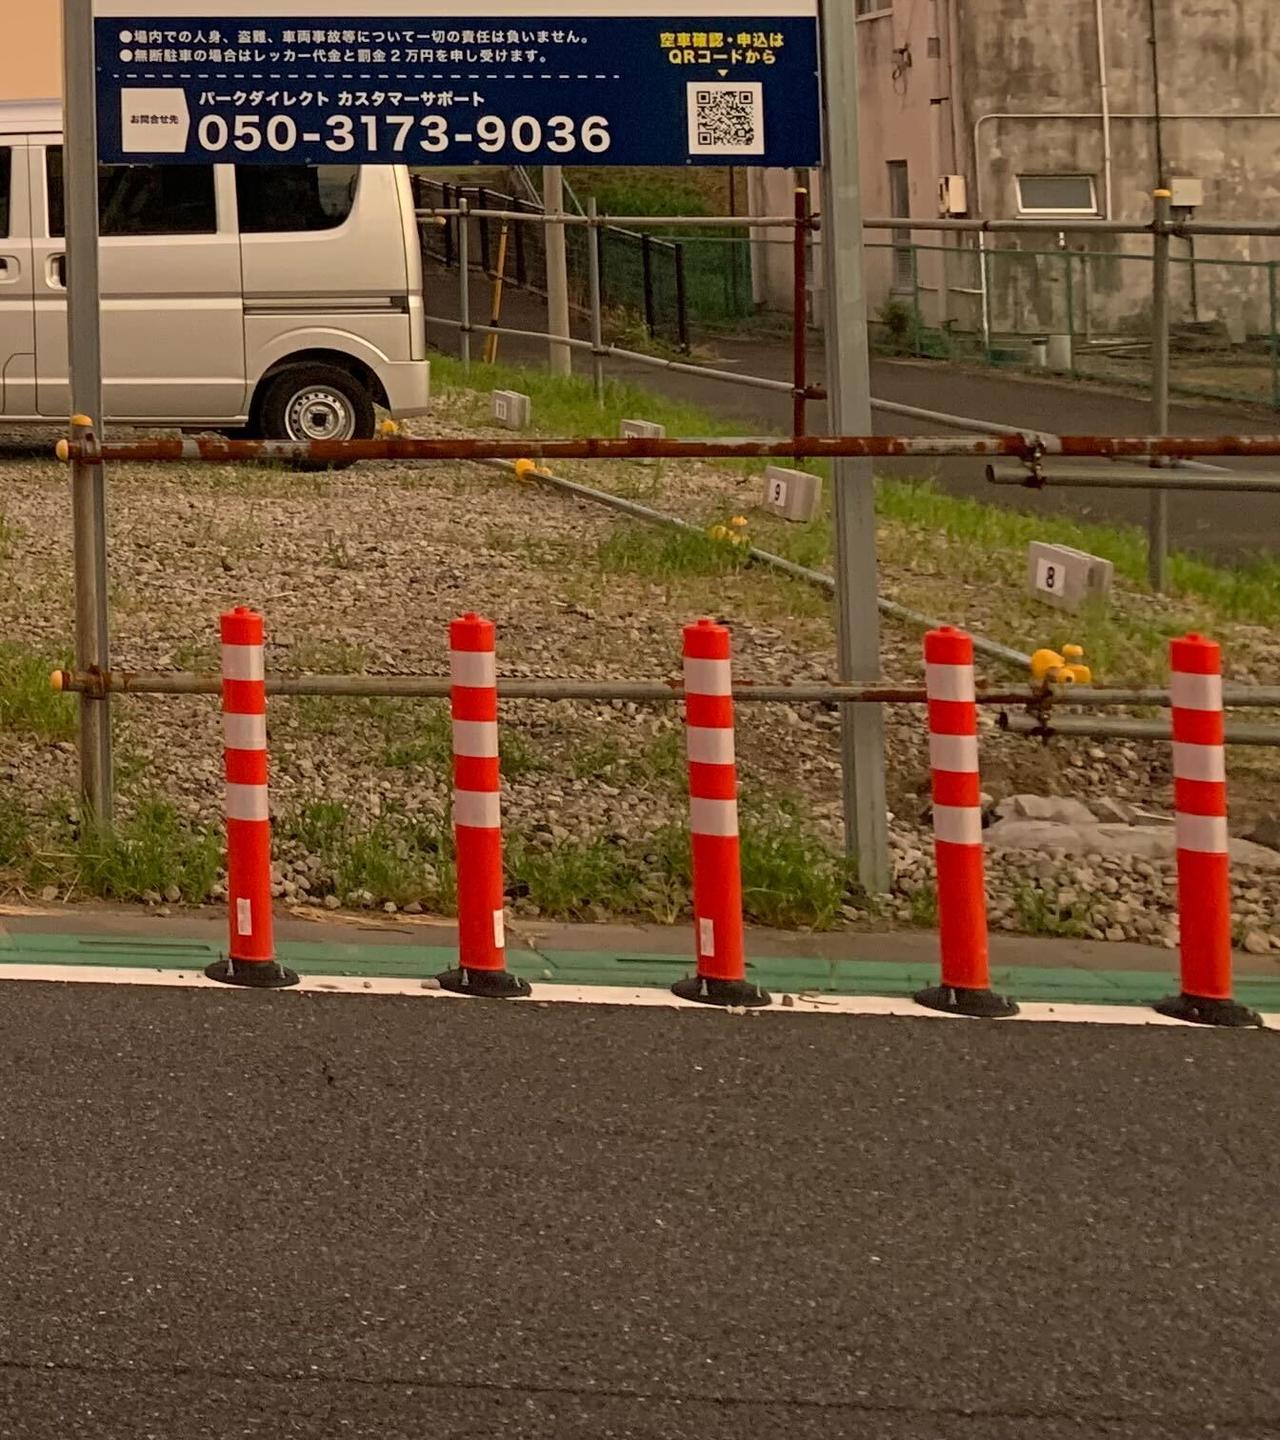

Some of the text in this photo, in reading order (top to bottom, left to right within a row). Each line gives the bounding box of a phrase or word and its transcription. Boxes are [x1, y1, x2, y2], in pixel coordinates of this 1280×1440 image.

[659, 32, 785, 49] 空車確認・申込は
[668, 50, 777, 65] QRコードから
[199, 90, 485, 107] パークダイレクト カスタマーサポート
[130, 115, 179, 125] お問合せ先
[198, 114, 612, 153] 050-3173-9036
[774, 483, 781, 501] 9
[1045, 566, 1055, 588] 8
